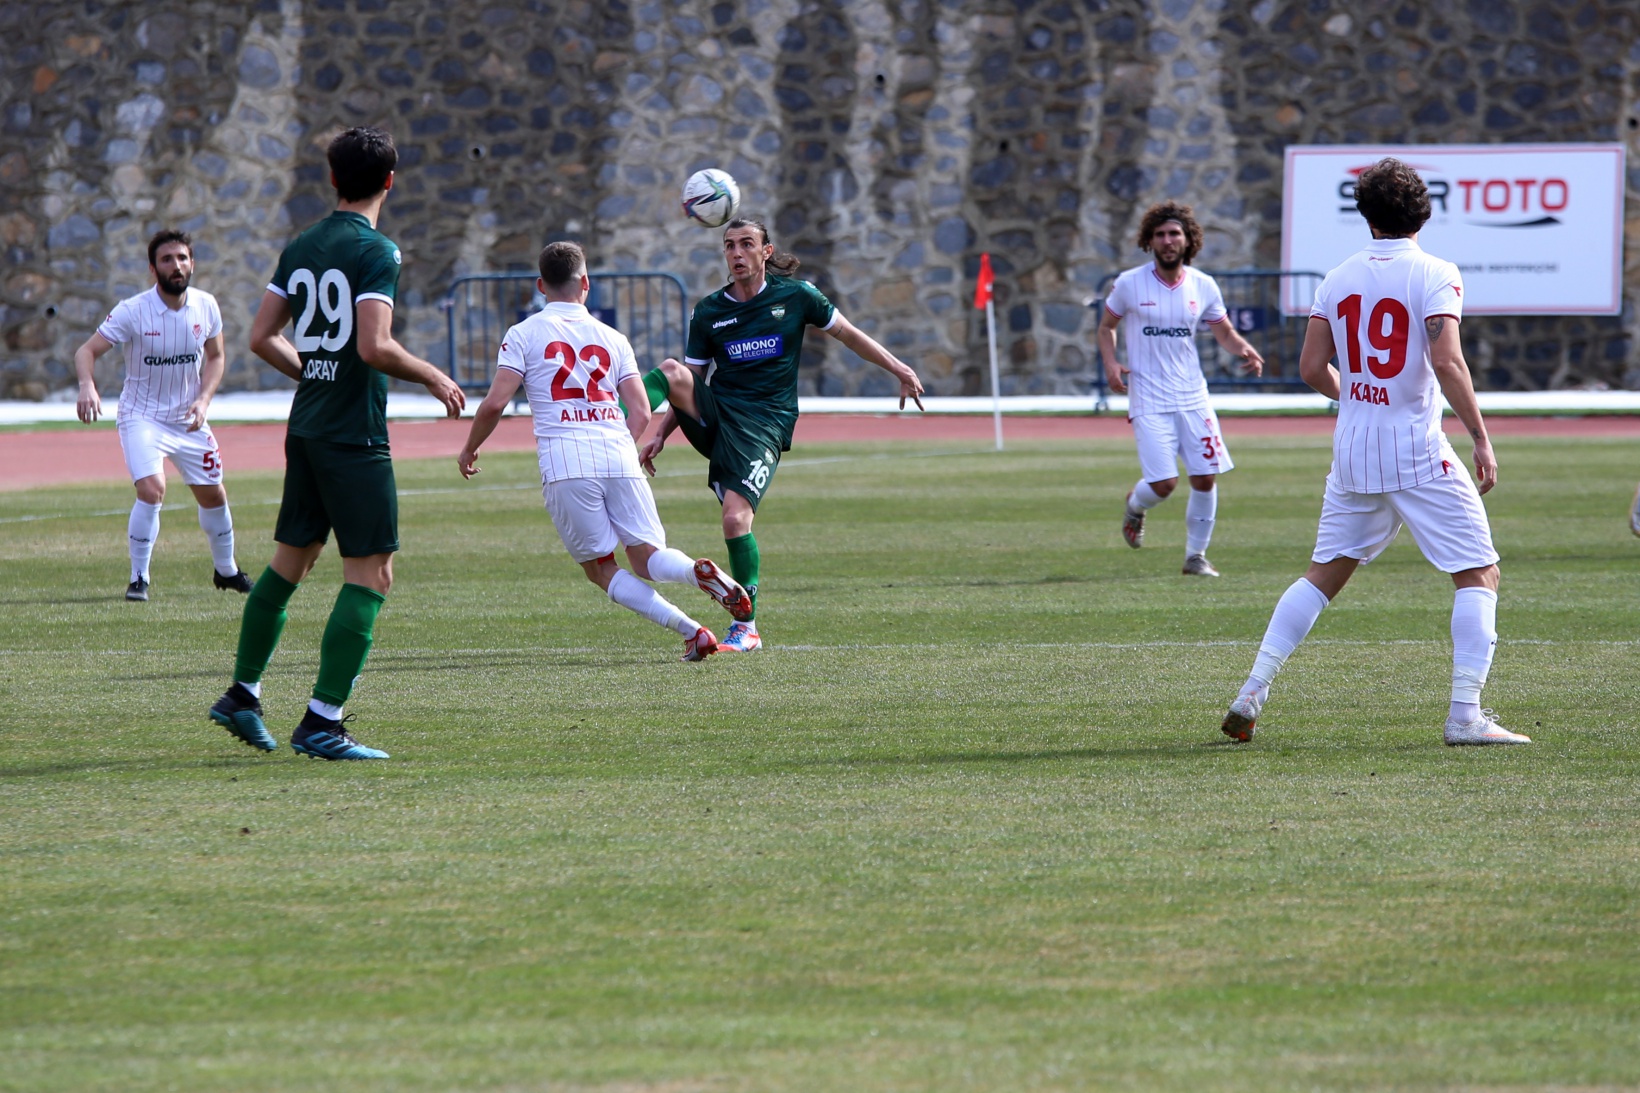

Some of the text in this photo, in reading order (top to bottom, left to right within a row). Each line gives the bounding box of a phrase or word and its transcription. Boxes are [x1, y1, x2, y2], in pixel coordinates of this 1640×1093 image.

[1457, 179, 1569, 213] TOTO
[287, 268, 353, 353] 29
[742, 338, 776, 352] MONO
[1337, 293, 1409, 380] 19
[743, 347, 777, 359] ELECTRIC
[544, 341, 615, 403] 22
[1350, 382, 1390, 406] KARA
[748, 459, 770, 490] 16
